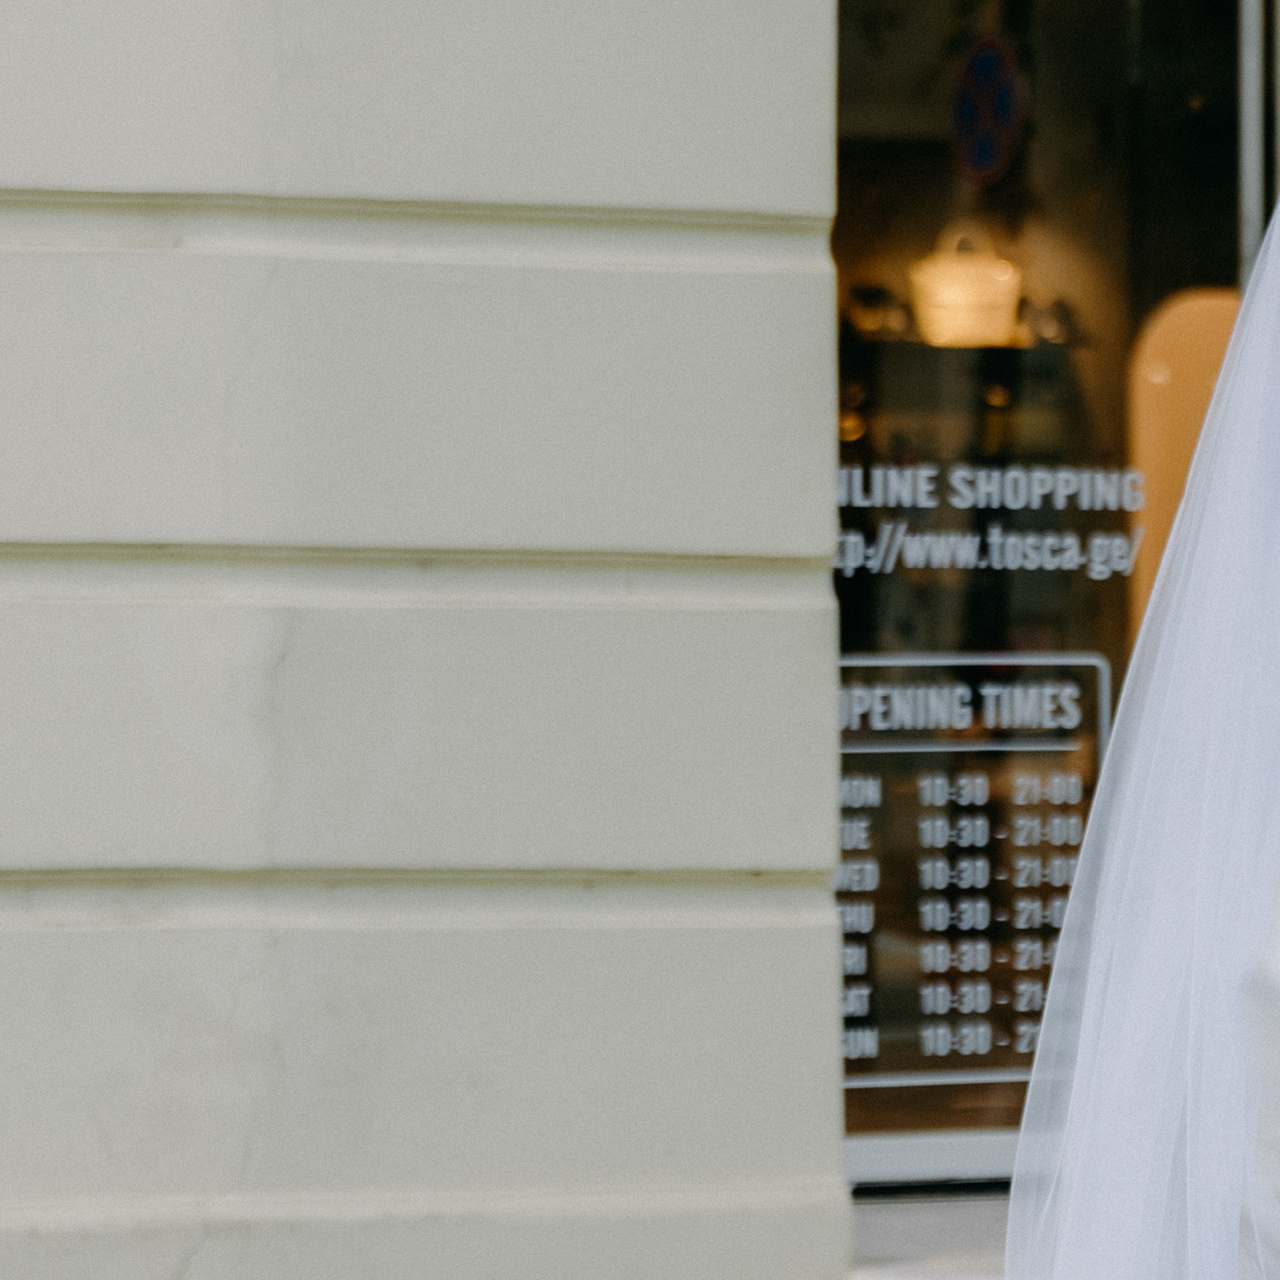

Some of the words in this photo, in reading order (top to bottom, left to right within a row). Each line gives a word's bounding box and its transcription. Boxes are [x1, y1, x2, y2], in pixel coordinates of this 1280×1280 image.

[839, 466, 939, 508] LINE
[949, 466, 1145, 511] SHOPPING
[836, 522, 1146, 580] p://www.tosca.ge/
[980, 684, 1082, 729] TIMES
[918, 775, 990, 806] 10:30
[918, 817, 990, 848] 10:30
[919, 858, 990, 890] 10:30
[919, 900, 991, 931] 10:30
[1013, 898, 1068, 929] 21:0
[920, 941, 991, 973] 10:30
[920, 983, 992, 1015] 10:30
[920, 1024, 992, 1057] 10:30
